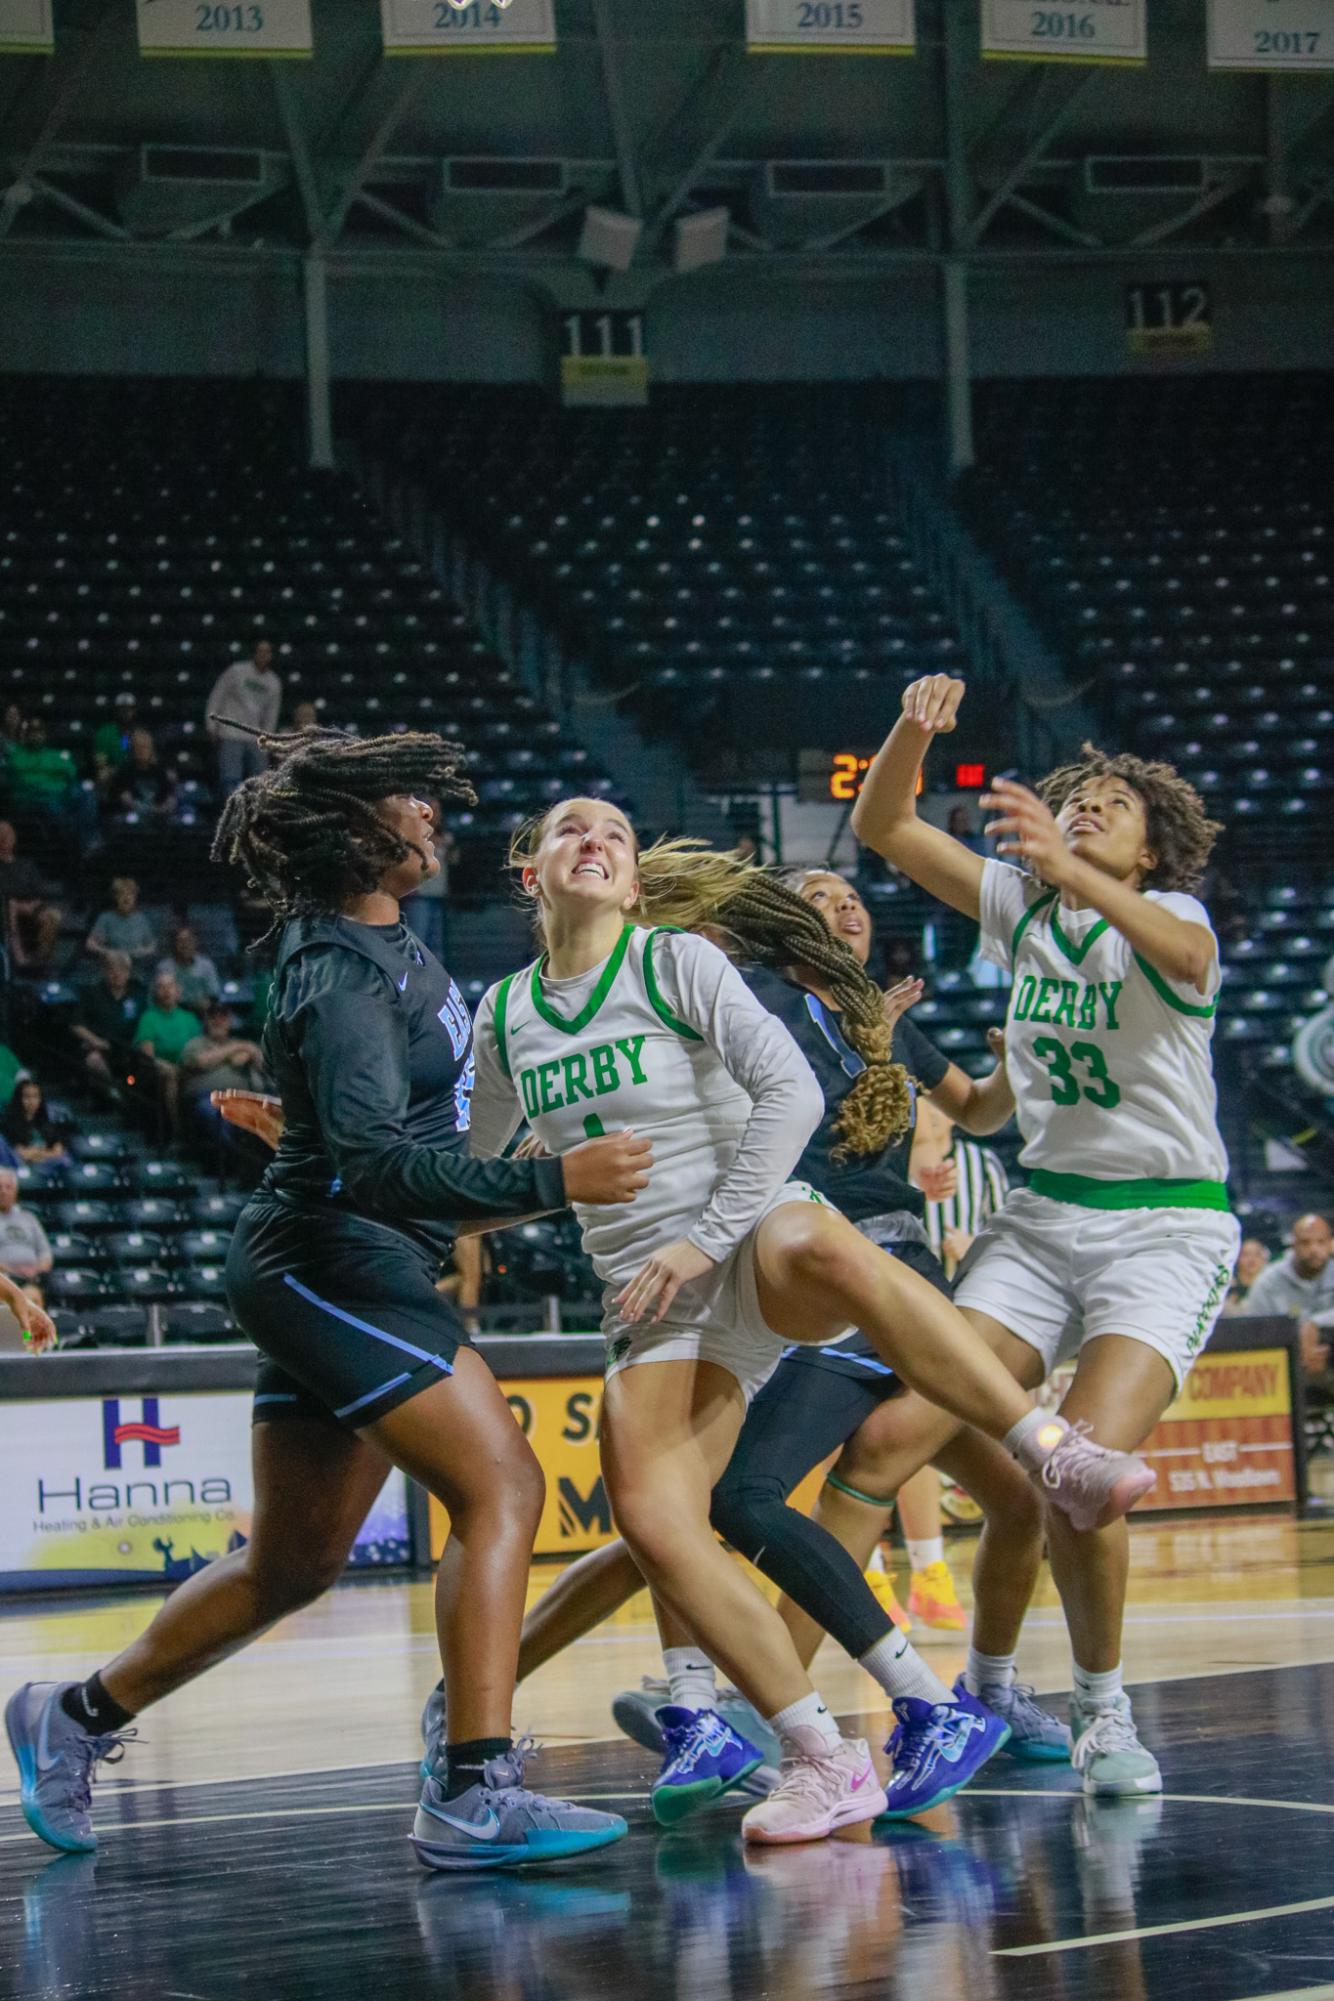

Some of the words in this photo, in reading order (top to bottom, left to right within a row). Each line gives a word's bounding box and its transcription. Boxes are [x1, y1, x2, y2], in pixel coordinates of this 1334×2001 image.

[196, 4, 265, 32] 2013
[433, 2, 501, 28] 2014
[797, 3, 863, 28] 2015
[1031, 11, 1096, 38] 2016
[1254, 31, 1320, 53] 2017
[1130, 287, 1208, 330] 112
[564, 314, 643, 359] 111
[1013, 975, 1123, 1030] DERBY
[520, 1035, 648, 1119] DERBY
[1032, 1036, 1120, 1109] 33
[38, 1477, 231, 1513] Hanna
[33, 1518, 88, 1533] Heating
[91, 1517, 101, 1529] &
[105, 1514, 123, 1527] Air
[128, 1509, 212, 1526] Conditioning
